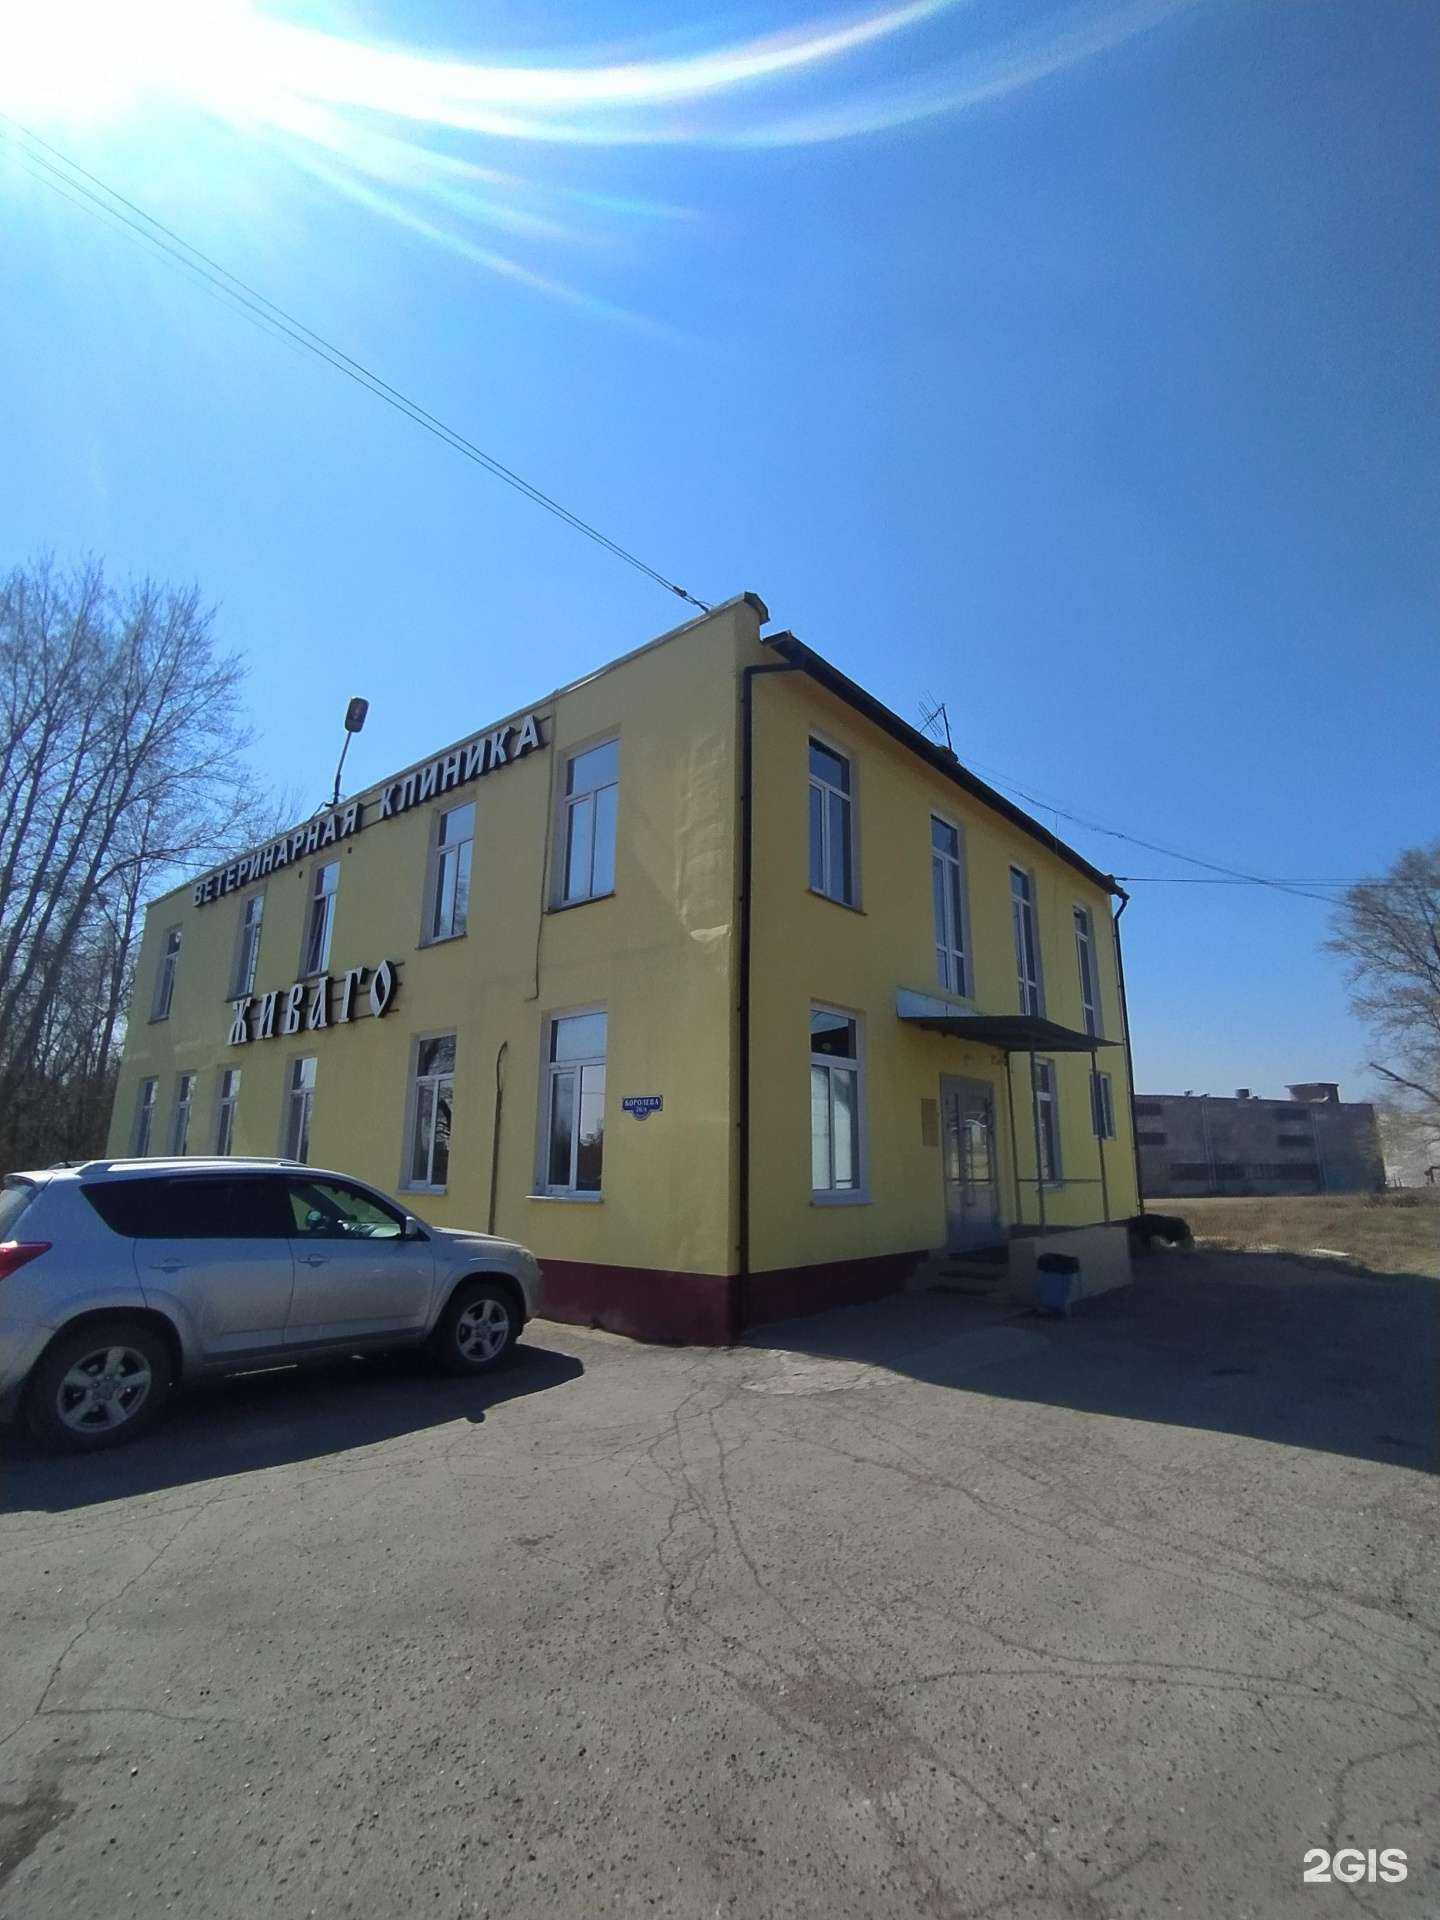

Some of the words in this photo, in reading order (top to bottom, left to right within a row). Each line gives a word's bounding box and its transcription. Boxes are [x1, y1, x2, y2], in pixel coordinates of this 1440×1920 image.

[192, 802, 364, 907] ВЕТЕРИНАРНАЯ
[379, 714, 541, 819] КЛИНИКА
[227, 959, 393, 1046] ЖИВАГО
